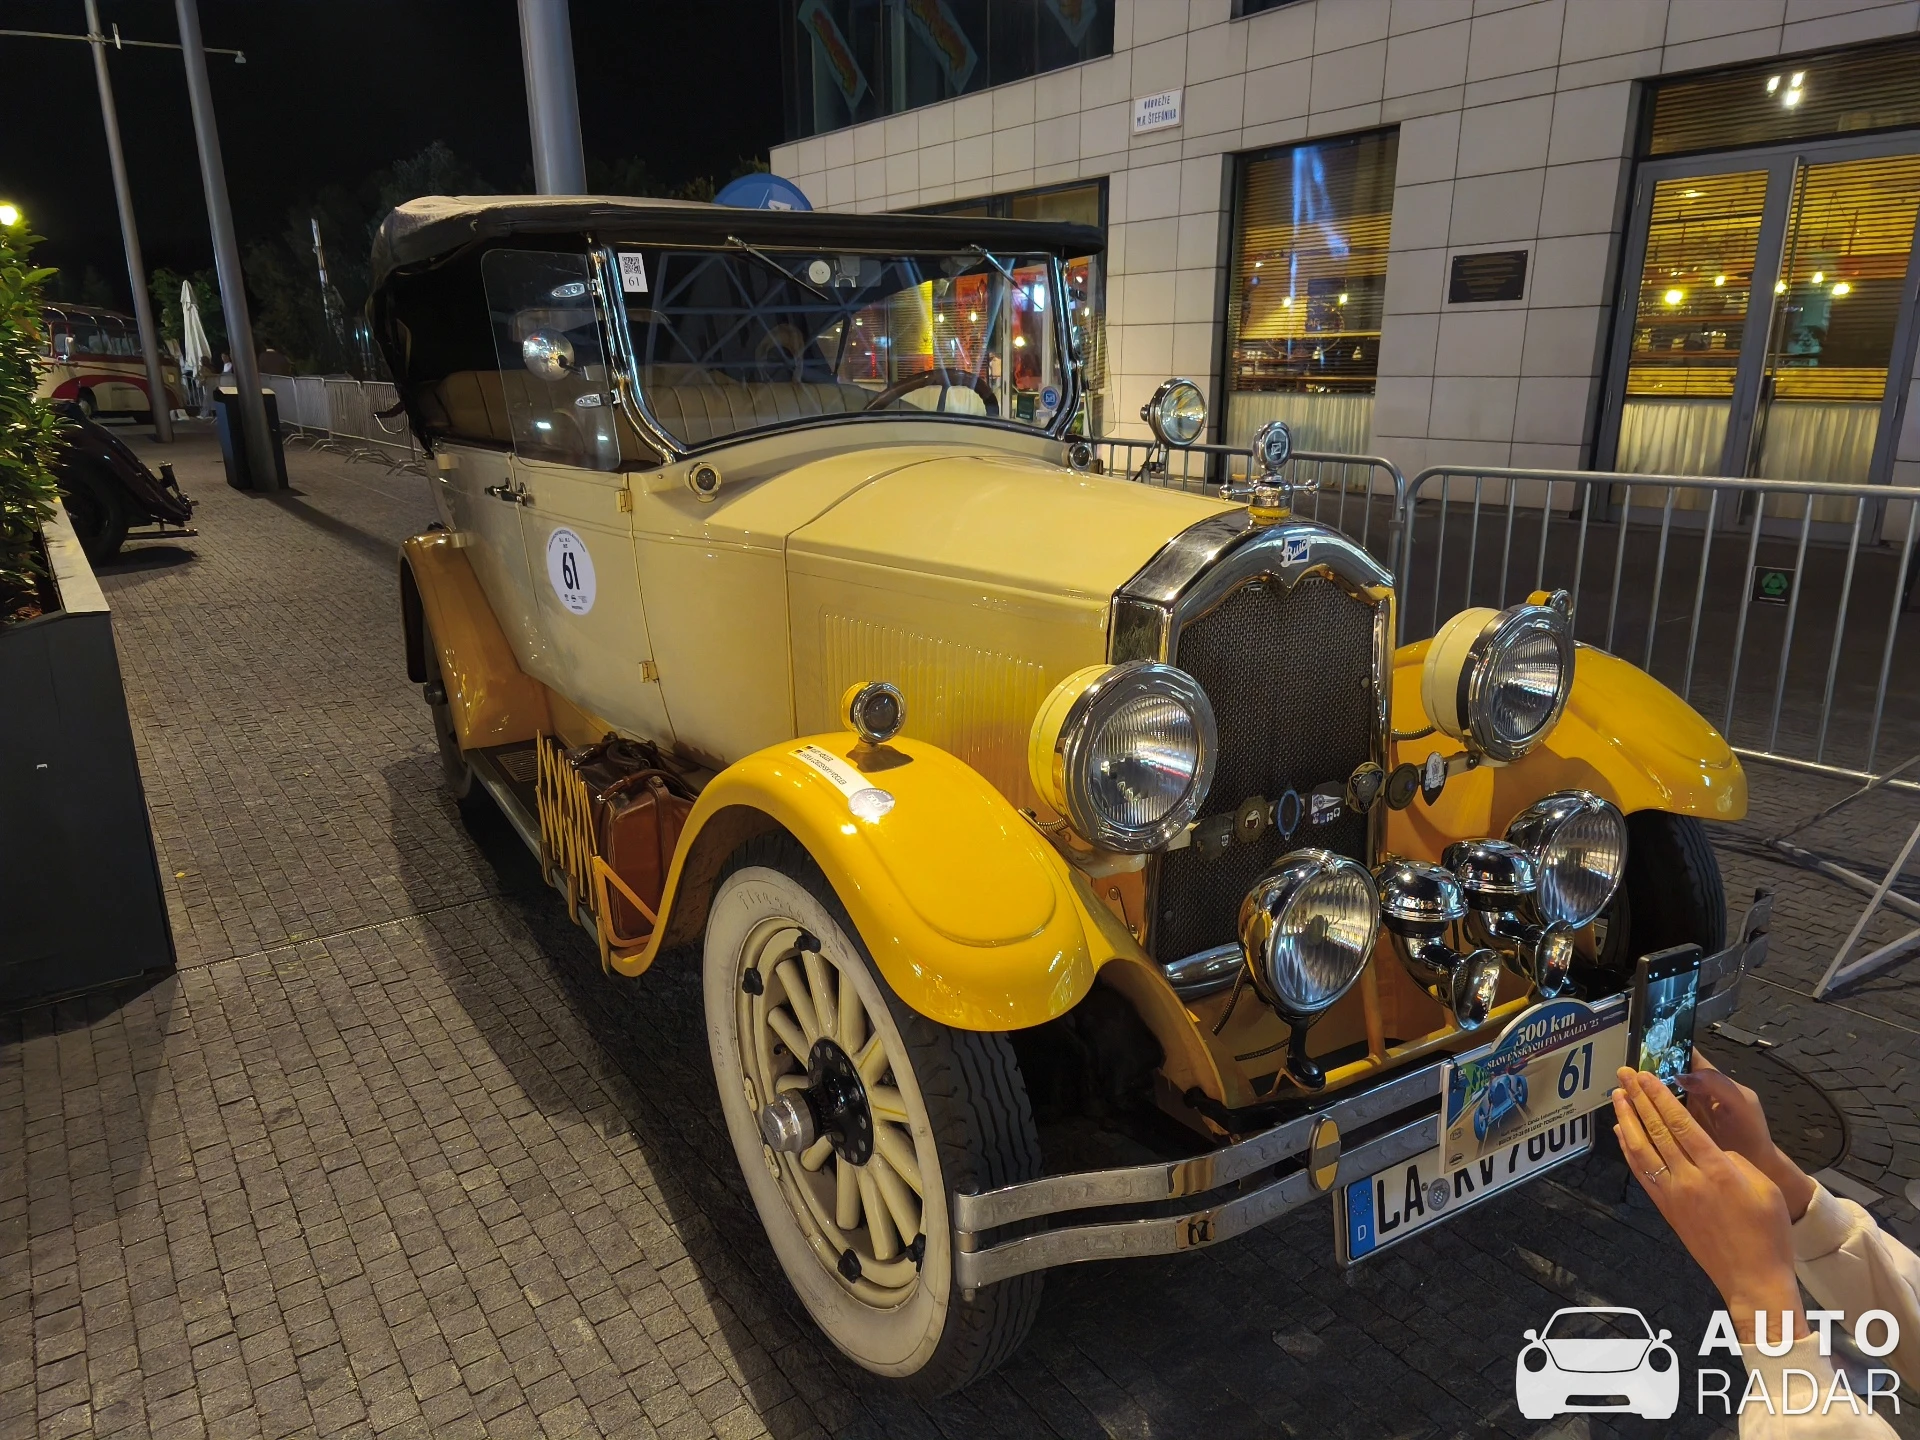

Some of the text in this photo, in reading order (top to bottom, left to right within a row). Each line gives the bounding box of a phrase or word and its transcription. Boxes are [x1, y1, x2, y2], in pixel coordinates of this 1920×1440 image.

[628, 276, 640, 287] 61
[562, 552, 580, 590] 61
[1514, 1019, 1547, 1047] 500
[1550, 1012, 1576, 1033] km
[1544, 1033, 1562, 1048] FIVA
[1563, 1023, 1588, 1039] RALLY
[1558, 1041, 1594, 1099] 61
[1377, 1165, 1424, 1235] LA
[1357, 1224, 1367, 1242] D
